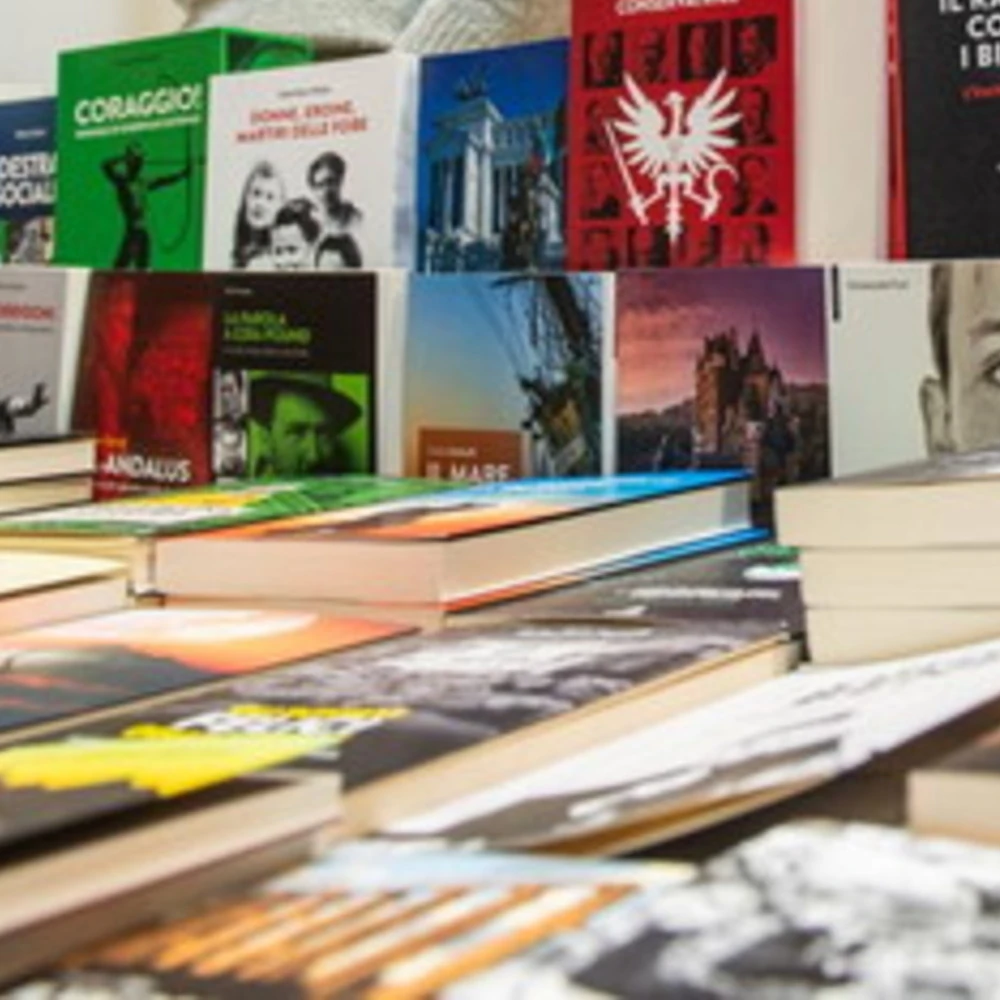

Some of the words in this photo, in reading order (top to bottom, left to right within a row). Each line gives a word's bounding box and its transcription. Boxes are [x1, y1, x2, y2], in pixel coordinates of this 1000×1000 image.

[961, 44, 969, 69] I
[74, 82, 203, 125] CORAGGIO!
[102, 453, 191, 482] ANDALUS
